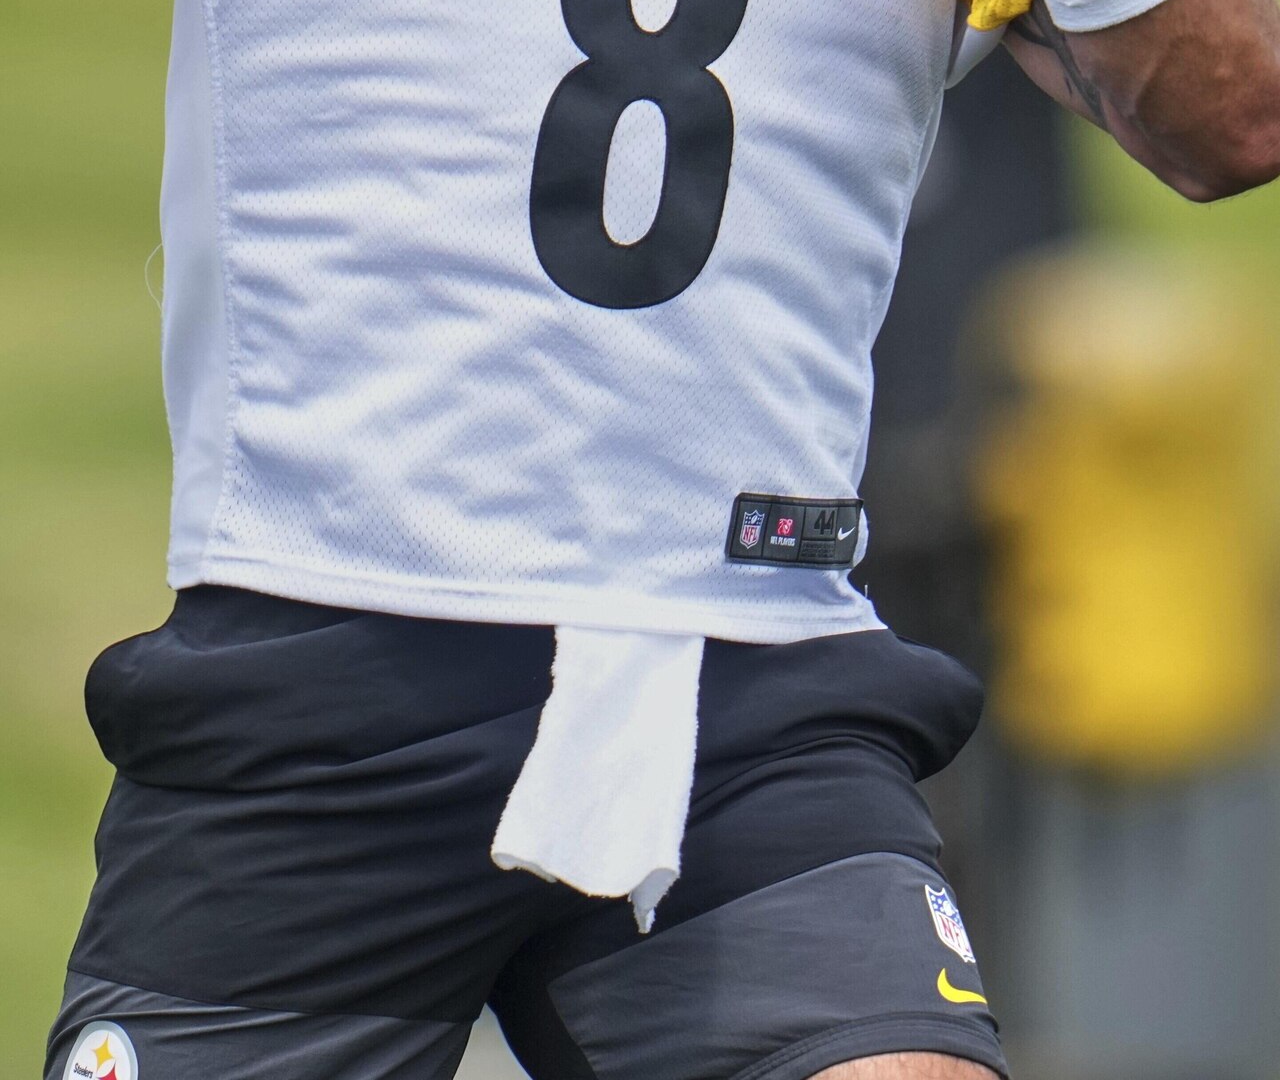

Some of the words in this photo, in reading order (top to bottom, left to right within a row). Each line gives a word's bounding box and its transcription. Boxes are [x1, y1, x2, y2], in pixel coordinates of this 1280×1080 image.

[814, 509, 836, 535] 44
[742, 526, 758, 543] NFL
[73, 1062, 94, 1079] Steelers
